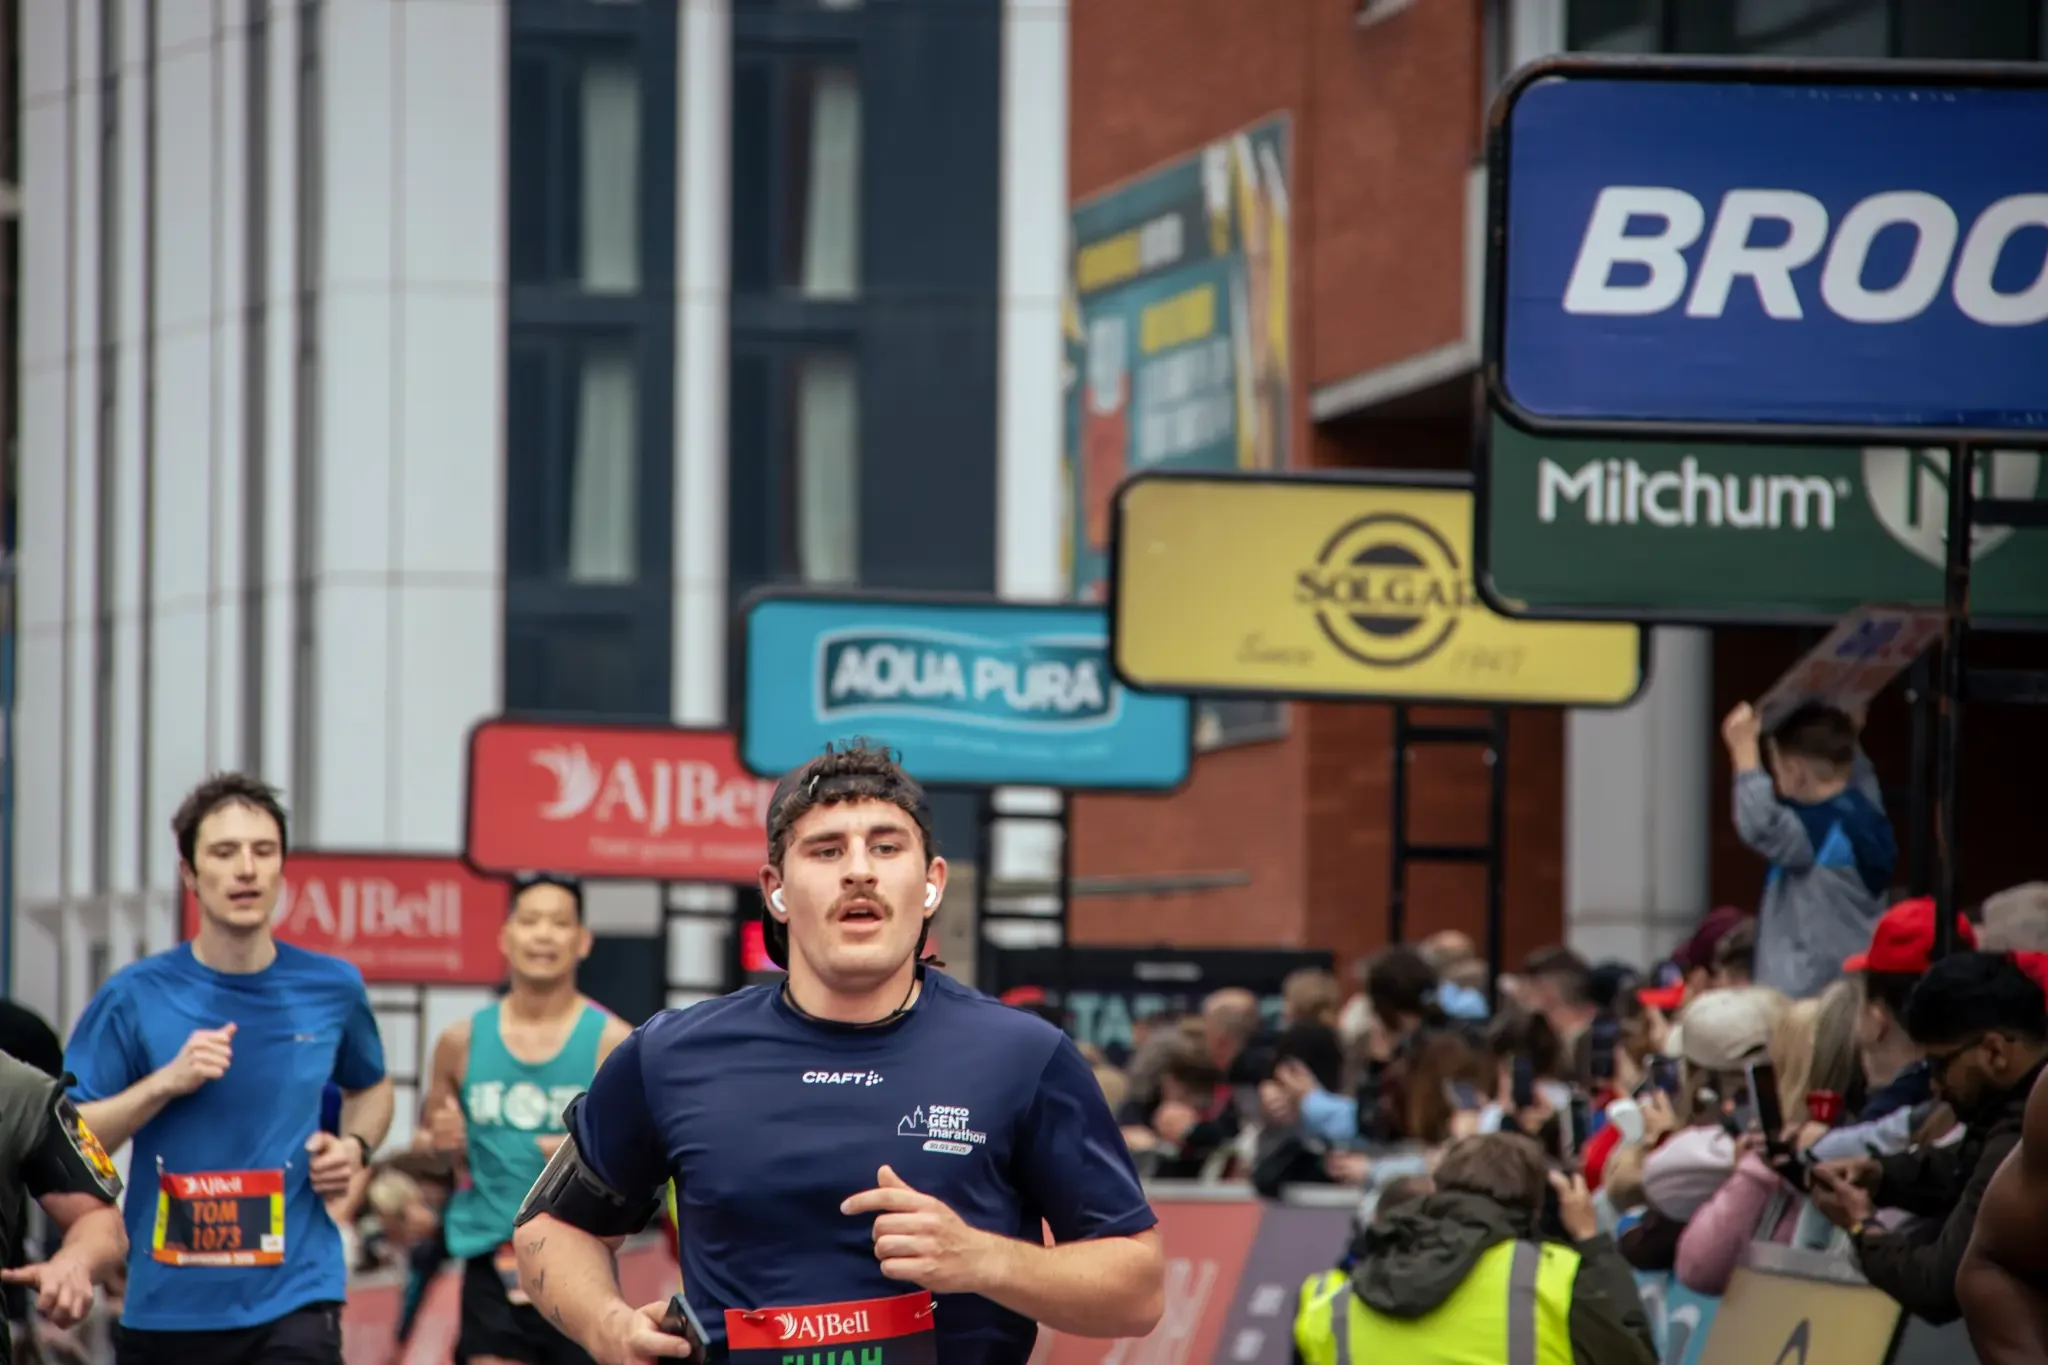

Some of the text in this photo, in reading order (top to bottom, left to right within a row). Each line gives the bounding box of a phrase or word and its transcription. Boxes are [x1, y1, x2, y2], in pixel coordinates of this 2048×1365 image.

[1563, 185, 2048, 326] BROO
[1538, 455, 1835, 531] Mitchum
[831, 643, 1104, 712] AQUA PURA
[594, 755, 770, 836] AJBel
[802, 1070, 866, 1085] CRAFT
[928, 1114, 970, 1130] GENT
[929, 1105, 970, 1117] SOFICO
[928, 1128, 987, 1145] marathon
[192, 1199, 239, 1224] TOM
[192, 1224, 242, 1251] 1073
